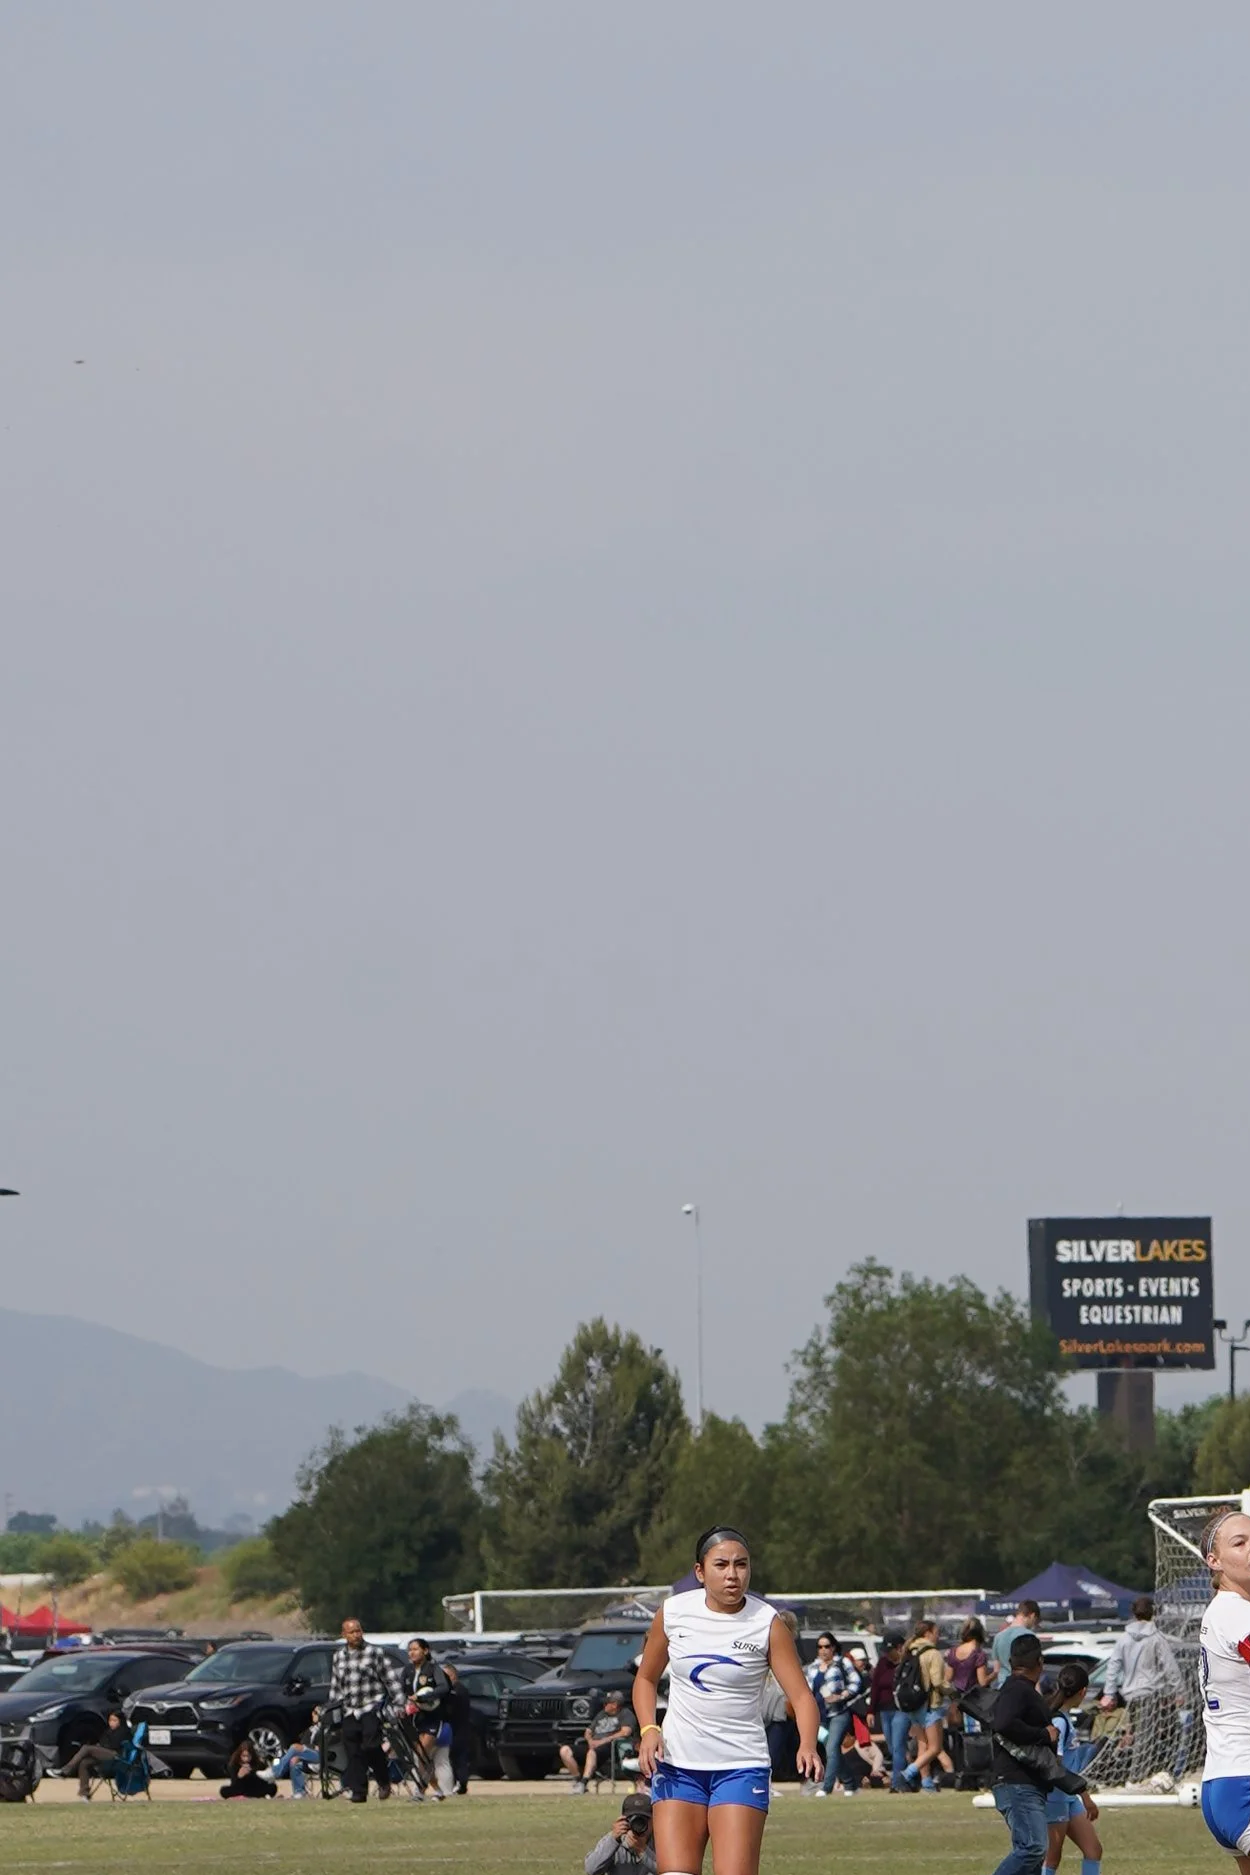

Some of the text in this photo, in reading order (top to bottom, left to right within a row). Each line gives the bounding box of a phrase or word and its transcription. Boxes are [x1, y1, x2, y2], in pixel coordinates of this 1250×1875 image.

[1056, 1240, 1207, 1262] SILVERLAKES
[1062, 1277, 1200, 1298] SPORTS EVENTS
[1079, 1305, 1183, 1325] EQUESTRIAN
[732, 1641, 760, 1652] SURF
